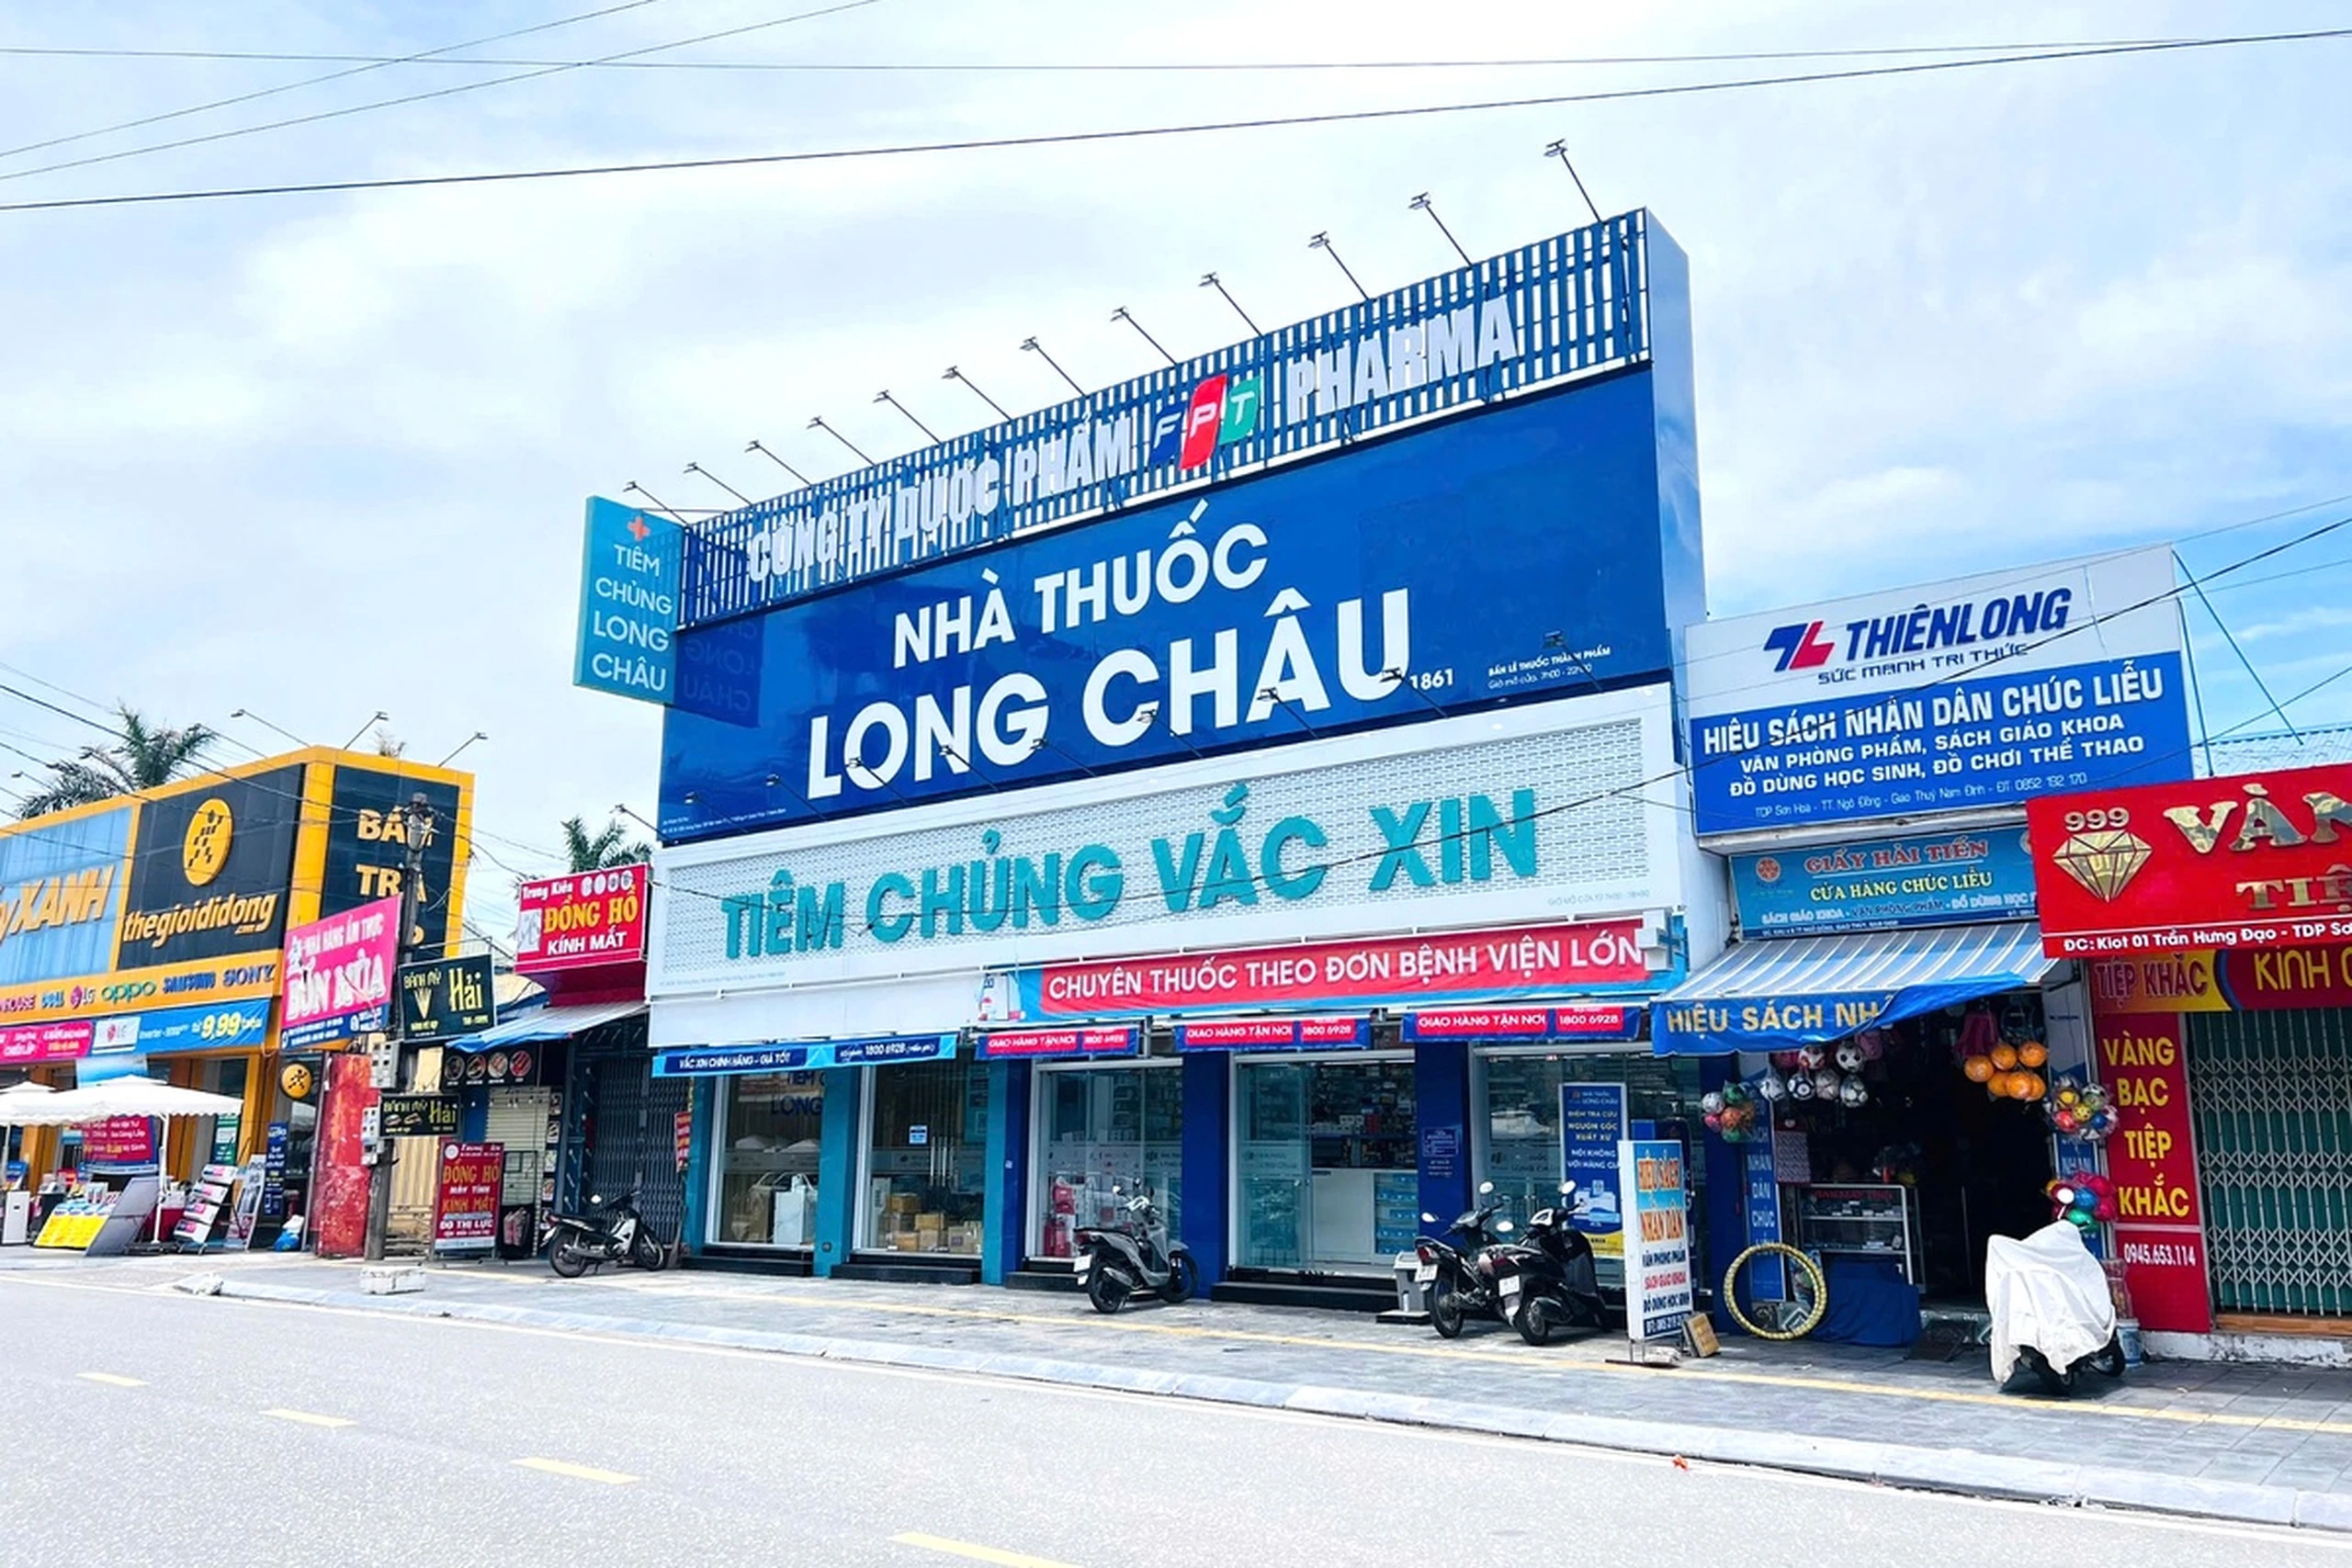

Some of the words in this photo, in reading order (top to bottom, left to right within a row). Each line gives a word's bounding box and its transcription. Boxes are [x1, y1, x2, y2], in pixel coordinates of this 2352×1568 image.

[749, 511, 840, 583] CÔNG
[846, 495, 890, 557] TY
[1012, 412, 1135, 507] PHẨM
[1153, 389, 1257, 449] FPT
[1288, 295, 1518, 424] PHARMA
[614, 544, 660, 577] TIÊM
[595, 577, 673, 615] CHỦNG
[894, 568, 1016, 669] NHÀ
[1035, 499, 1269, 635] THUỐC
[594, 610, 669, 651] LONG
[592, 653, 666, 692] CHÂU
[808, 671, 1049, 800] LONG
[1082, 587, 1410, 747] CHÂU
[1768, 709, 1837, 746] SÁCH
[1931, 686, 1993, 727] DÂN
[2002, 675, 2083, 717] CHÚC
[2093, 660, 2164, 706] LIỄU
[1740, 755, 1780, 774] VĂN
[1786, 745, 1854, 769] PHÒNG
[1934, 726, 1992, 750] SÁCH
[1999, 719, 2052, 742] GIÁO
[2061, 714, 2125, 736] KHOA
[1729, 773, 1757, 797] ĐỒ
[1763, 773, 1817, 794] DÙNG
[1824, 768, 1865, 789] HỌC
[1932, 750, 1963, 774] ĐỒ
[1971, 748, 2021, 771] CHƠI
[2030, 737, 2074, 764] THỂ
[2081, 736, 2144, 758] THAO
[2064, 807, 2130, 832] 999
[721, 869, 845, 960] TIÊM
[865, 828, 1125, 943] CHỦNG
[1151, 782, 1329, 912] VẮC
[1369, 787, 1537, 891] XIN
[1804, 846, 1865, 874] GIẤY
[1872, 841, 1919, 868] HẢI
[1925, 834, 1989, 861] TIẾN
[1849, 877, 1897, 898] HÀNG
[1902, 872, 1949, 894] CHÚC
[123, 893, 278, 948] thegioididong
[2194, 929, 2237, 947] Hưng
[2240, 927, 2277, 944] Đạo
[2292, 923, 2325, 938] TDP
[547, 933, 585, 955] KÍNH
[222, 964, 276, 987] SONY
[1049, 966, 1142, 1000] CHUYÊN
[1149, 956, 1238, 994] THUỐC
[1245, 958, 1317, 987] THEO
[1325, 953, 1390, 982] ĐƠN
[1399, 943, 1477, 985] BỆNH
[1487, 934, 1560, 979] VIỆN
[1571, 930, 1645, 966] LỚN
[1419, 1016, 1451, 1028] GIAO
[1453, 1013, 1489, 1026] HÀNG
[1559, 1014, 1586, 1026] 1800
[1589, 1014, 1620, 1025] 6928
[1666, 1003, 1729, 1039] HIỆU
[1742, 998, 1824, 1032] SÁCH
[2103, 1030, 2176, 1066] VÀNG
[2117, 1077, 2169, 1115] BẠC
[2124, 1122, 2173, 1168] TIỆP
[2118, 1173, 2190, 1218] KHẮC
